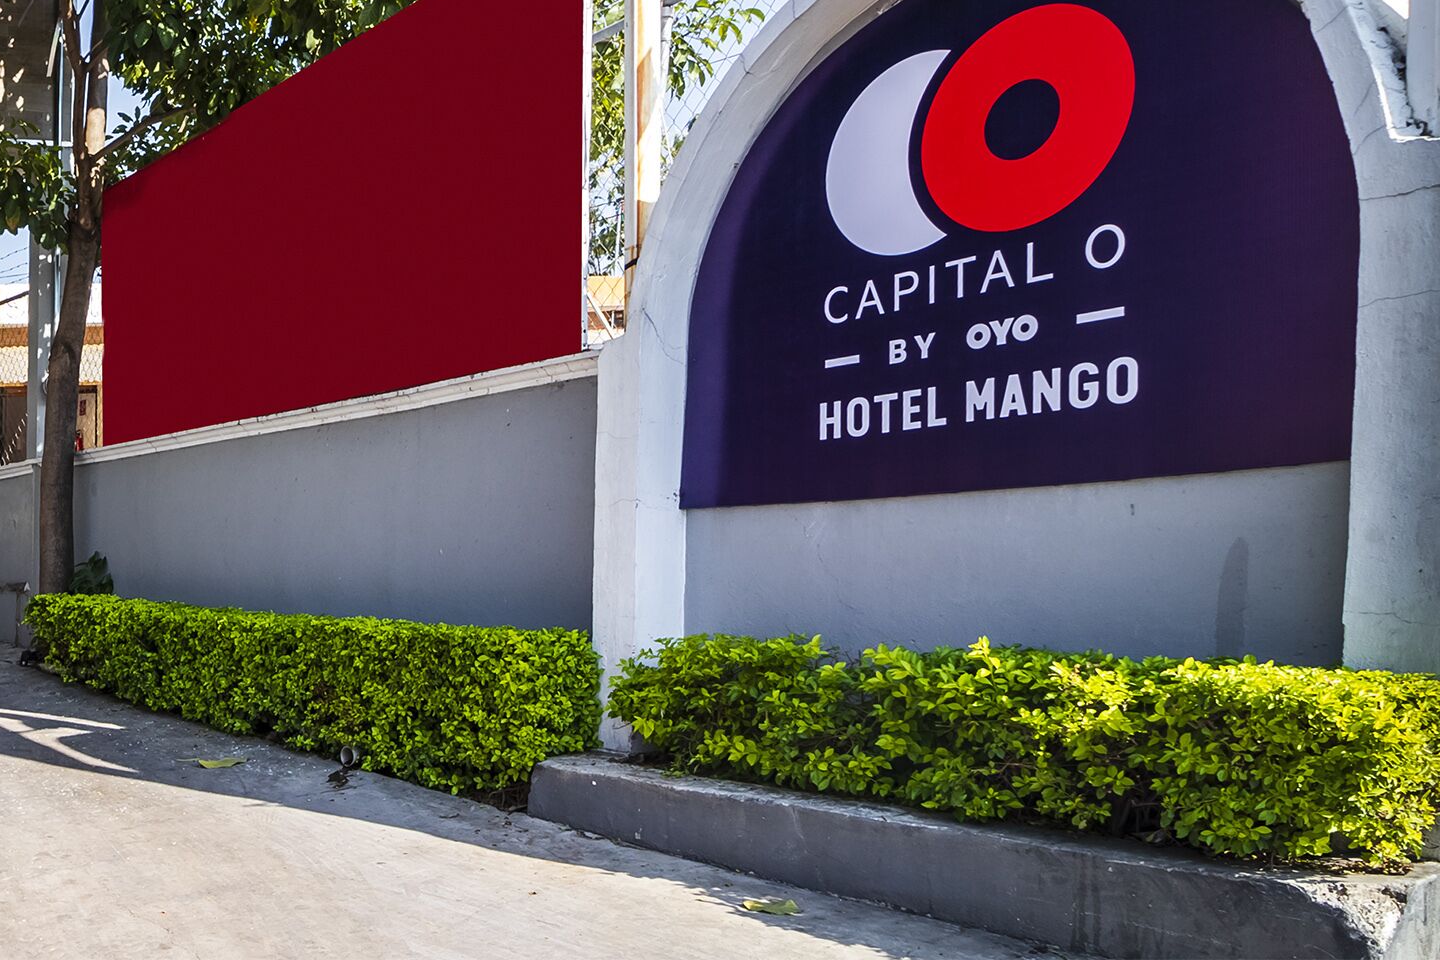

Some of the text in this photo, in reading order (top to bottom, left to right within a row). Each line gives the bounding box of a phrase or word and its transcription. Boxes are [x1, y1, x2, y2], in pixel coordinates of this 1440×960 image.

[823, 223, 1127, 324] CAPITAL O
[888, 314, 1039, 365] BY OYO
[819, 356, 1139, 441] HOTEL MANGO
